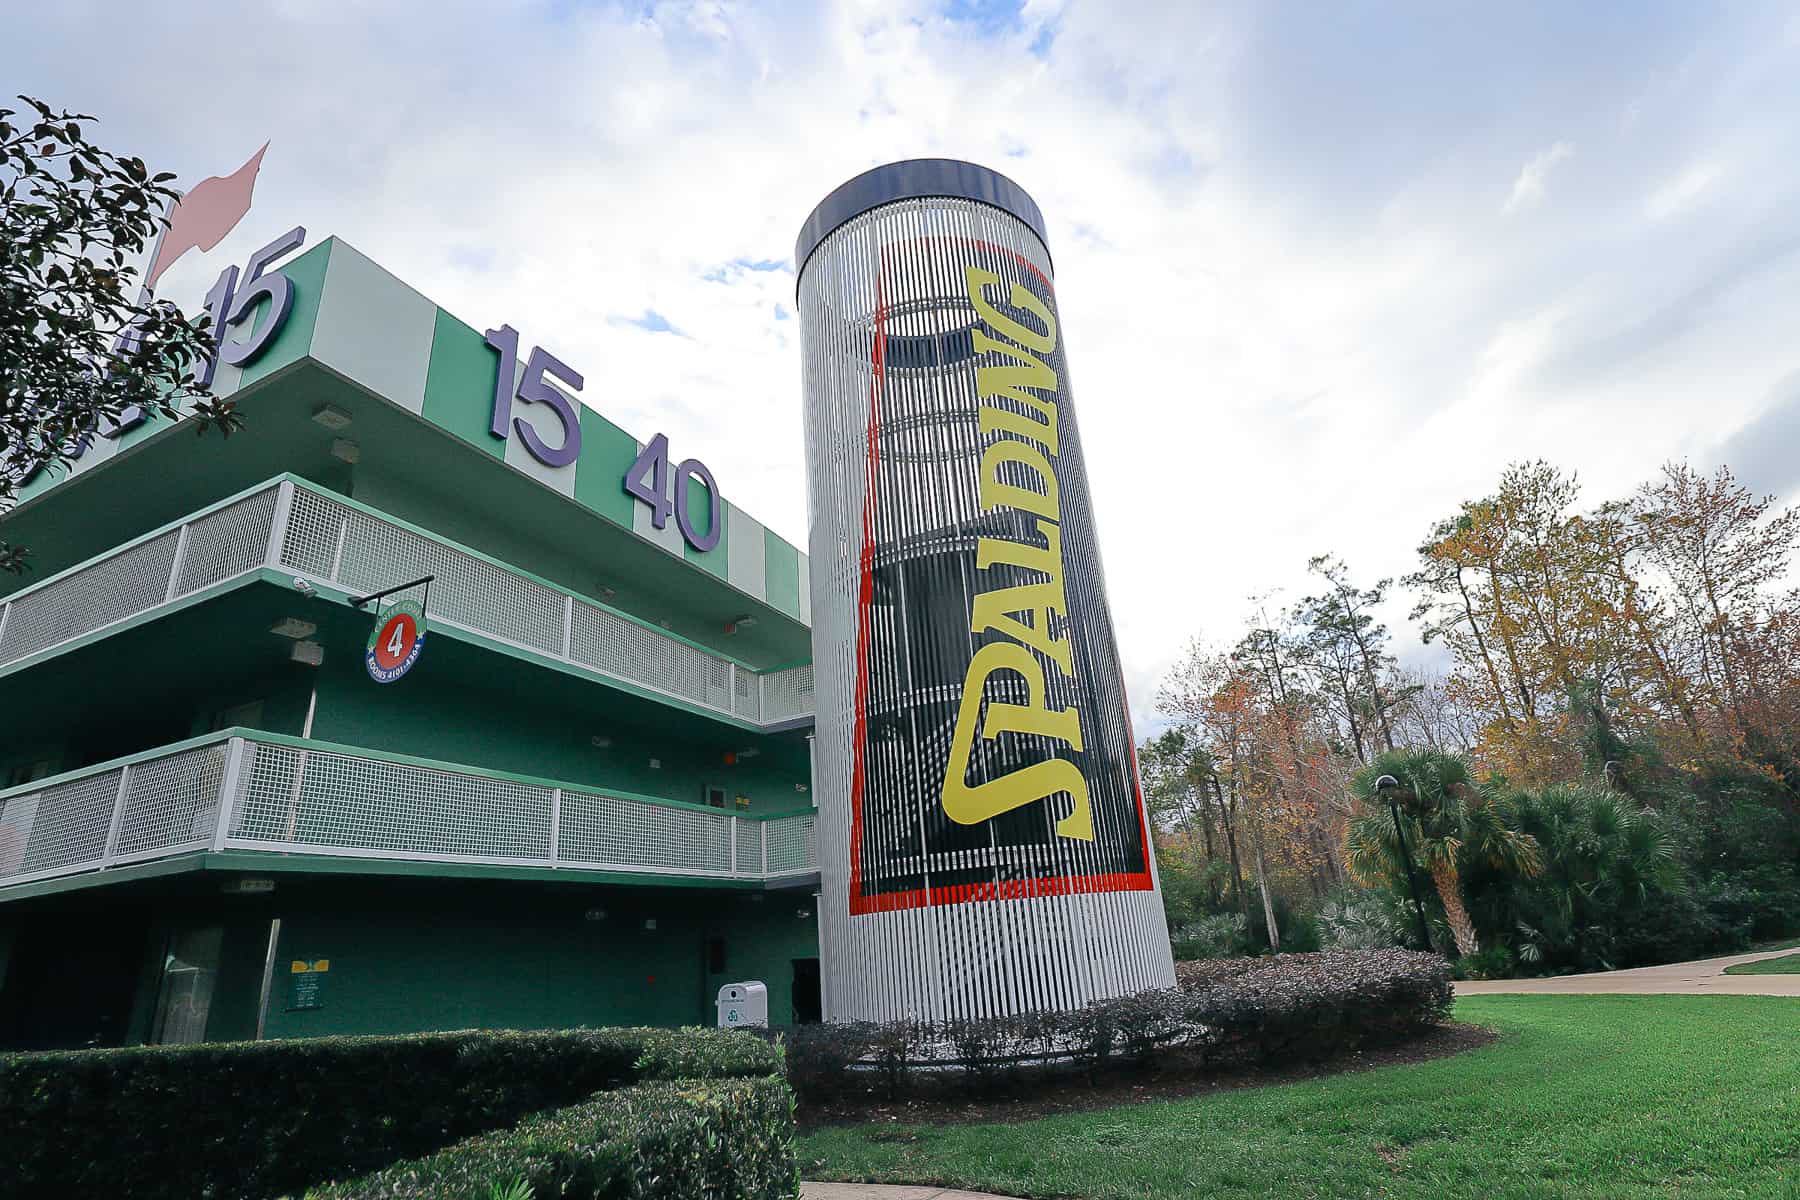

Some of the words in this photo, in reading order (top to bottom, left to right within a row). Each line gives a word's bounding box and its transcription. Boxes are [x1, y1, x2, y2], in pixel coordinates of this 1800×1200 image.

[192, 225, 306, 389] 15
[484, 323, 584, 468] 15
[624, 432, 721, 552] 40
[940, 264, 1094, 842] SPALDING
[369, 656, 387, 679] ROOMS
[387, 622, 404, 657] 4
